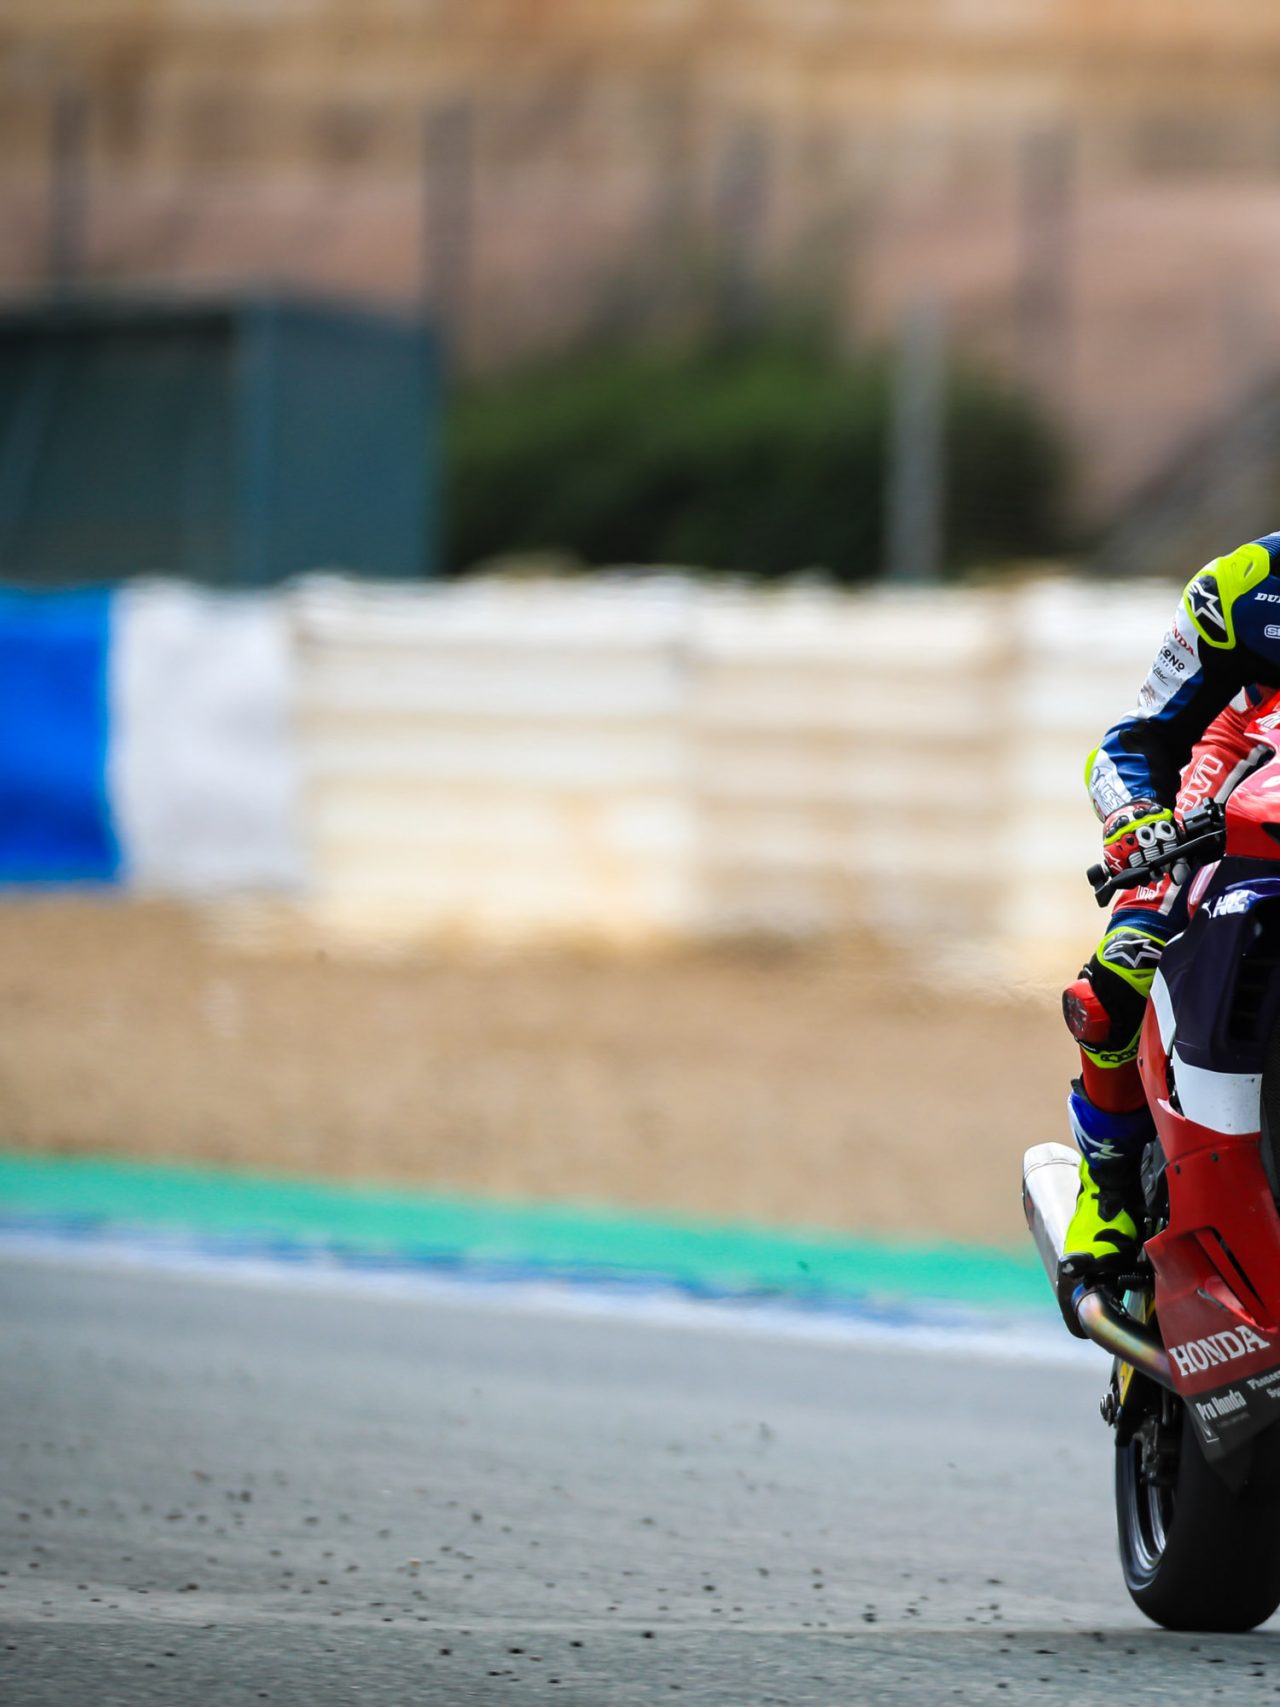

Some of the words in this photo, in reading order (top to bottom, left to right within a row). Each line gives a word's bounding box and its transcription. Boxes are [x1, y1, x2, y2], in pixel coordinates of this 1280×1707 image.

[1171, 618, 1196, 656] NDA
[1168, 1325, 1270, 1377] HONDA
[1195, 1402, 1217, 1421] Pro
[1211, 1389, 1247, 1415] Honda
